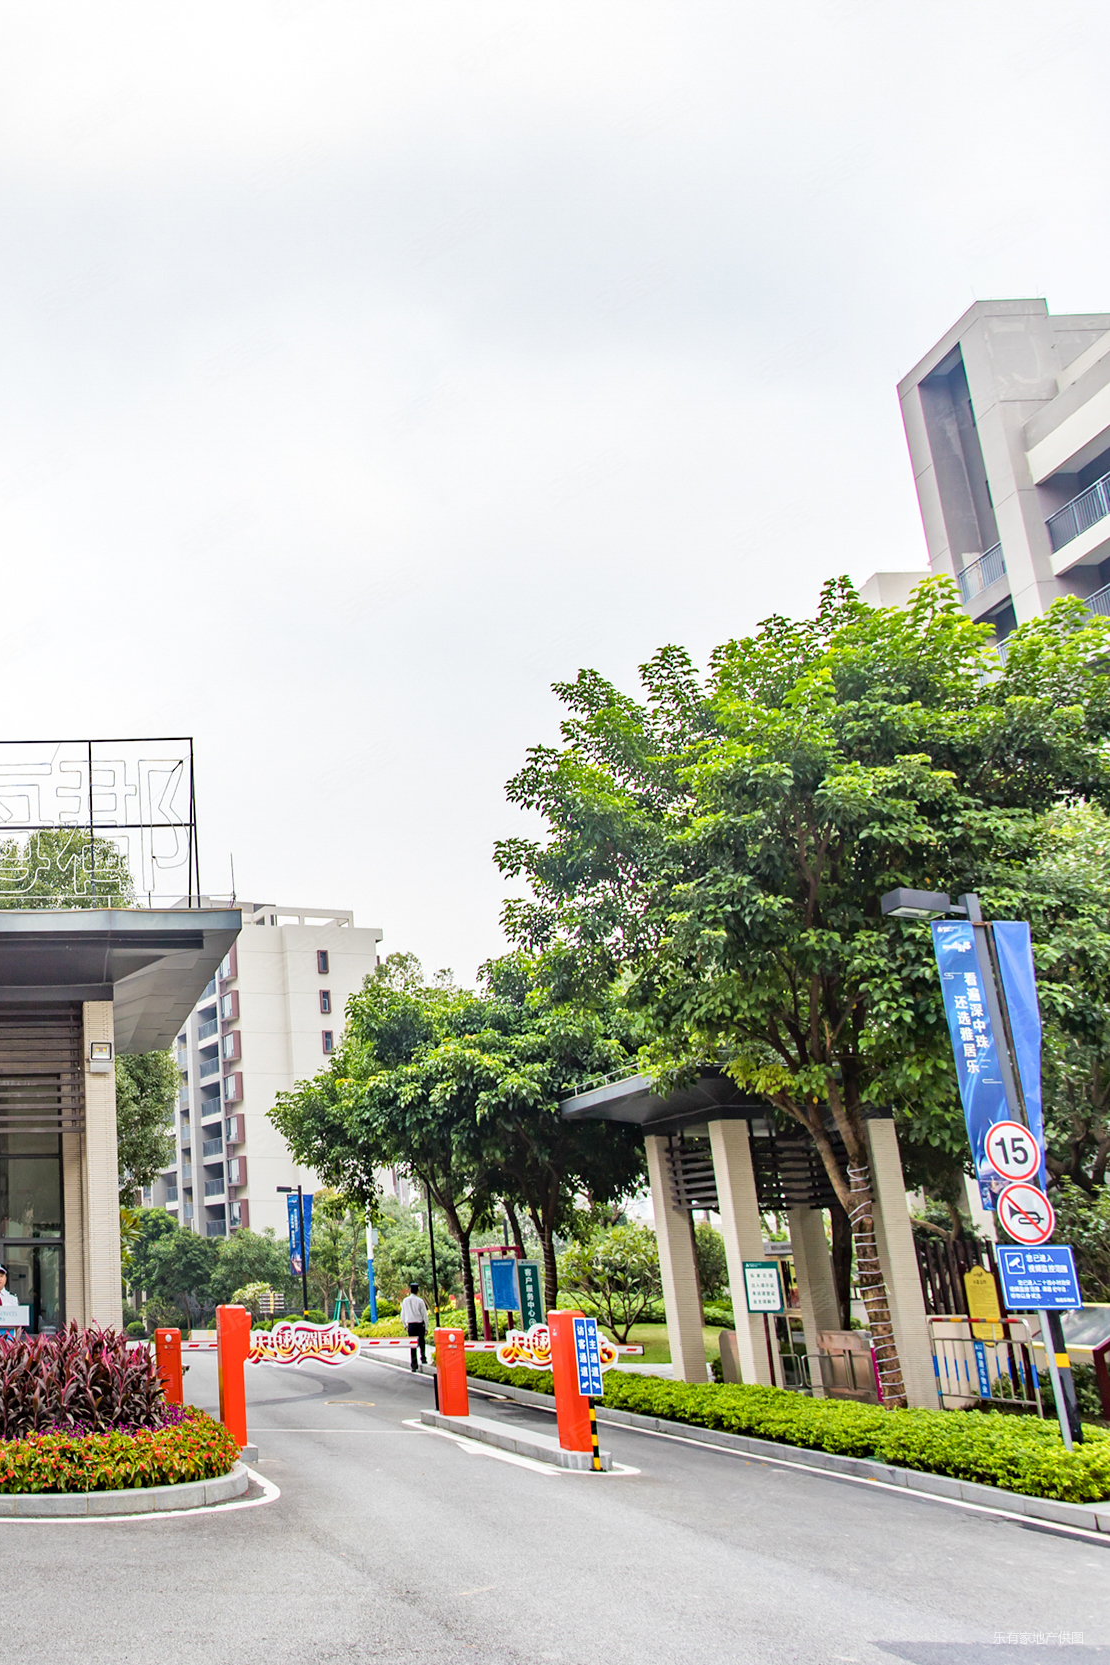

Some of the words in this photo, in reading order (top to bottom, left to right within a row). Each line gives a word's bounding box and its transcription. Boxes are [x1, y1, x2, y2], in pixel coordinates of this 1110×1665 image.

[953, 995, 980, 1074] 还选雅居乐
[963, 972, 990, 1049] 看遍深中珠
[995, 1137, 1028, 1165] 15
[1025, 1253, 1054, 1263] 您已进入
[524, 1268, 536, 1318] 客户服务中心
[577, 1325, 589, 1377] 访客通道
[588, 1326, 600, 1377] 业主通道
